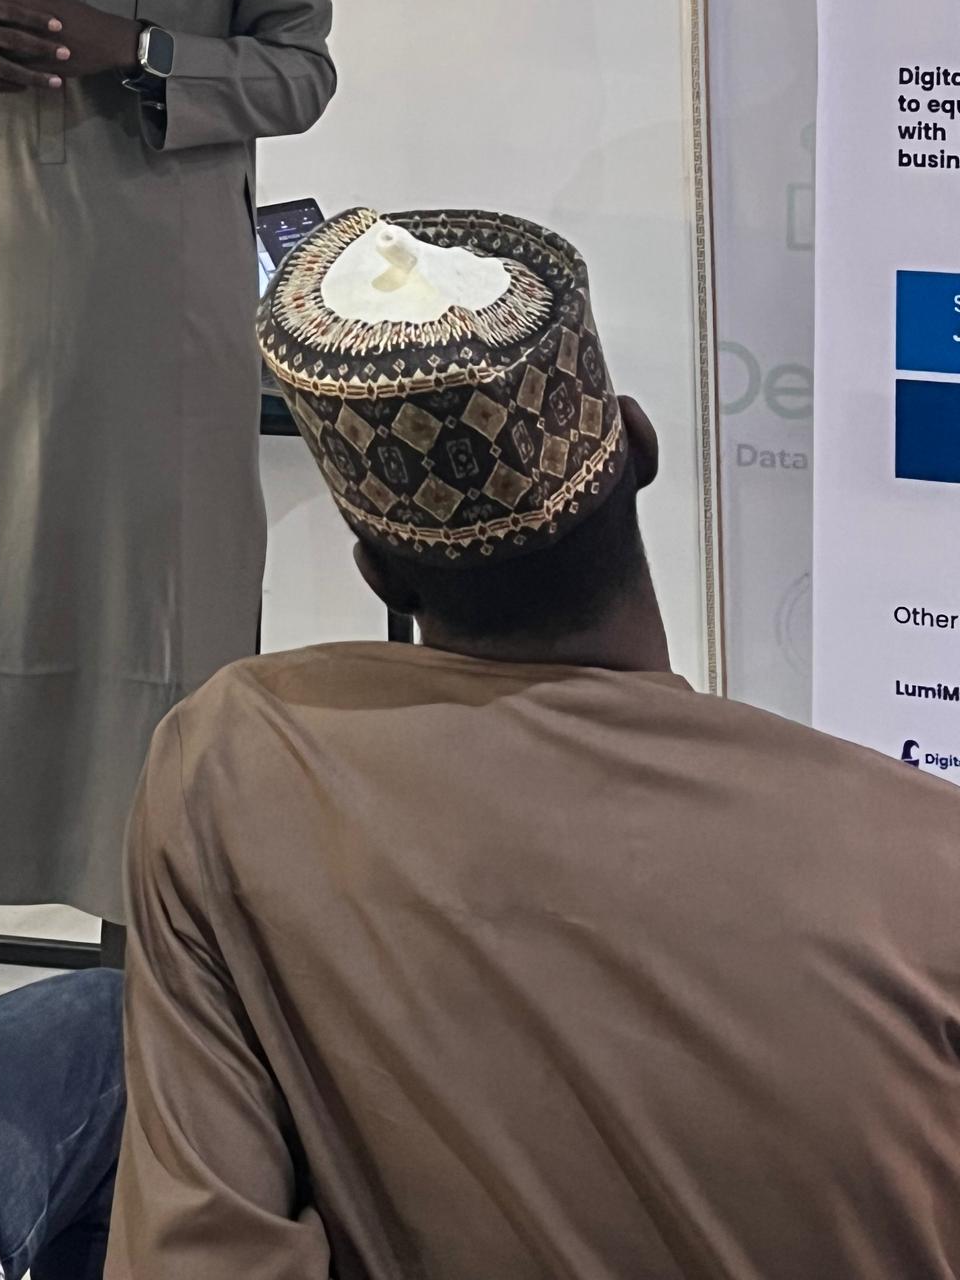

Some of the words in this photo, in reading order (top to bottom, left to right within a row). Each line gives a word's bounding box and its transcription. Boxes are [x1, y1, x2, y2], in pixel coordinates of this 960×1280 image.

[898, 95, 921, 112] to
[927, 99, 960, 120] eq
[898, 121, 946, 141] with
[898, 149, 960, 169] busin
[736, 443, 808, 470] Data
[894, 606, 959, 629] Other
[895, 679, 960, 702] LumiM
[925, 753, 960, 770] Digit
